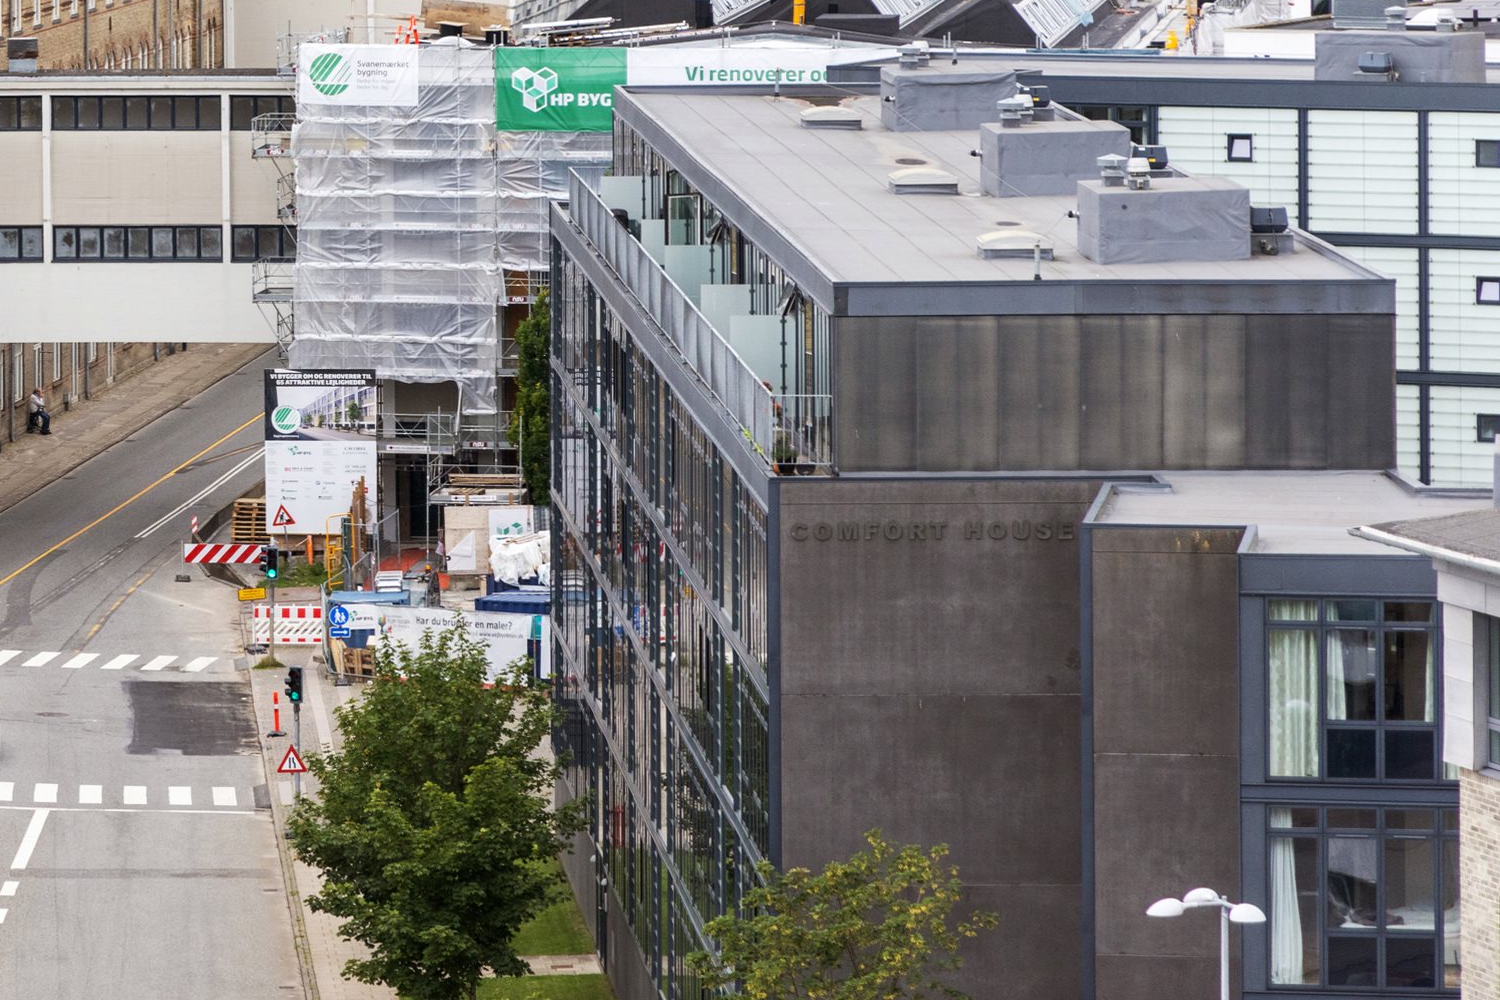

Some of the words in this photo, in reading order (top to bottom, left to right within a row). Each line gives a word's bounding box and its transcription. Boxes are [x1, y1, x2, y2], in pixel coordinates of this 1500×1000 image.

[356, 60, 409, 68] Svanemærket
[356, 68, 388, 77] bygning
[684, 65, 704, 81] Vi
[709, 69, 806, 82] renoverer
[550, 92, 575, 106] HP
[577, 92, 612, 106] BYG
[790, 520, 948, 542] COMFORT
[963, 520, 1076, 541] HOUSE
[415, 616, 429, 625] Har
[431, 616, 441, 626] du
[486, 621, 513, 630] maler?
